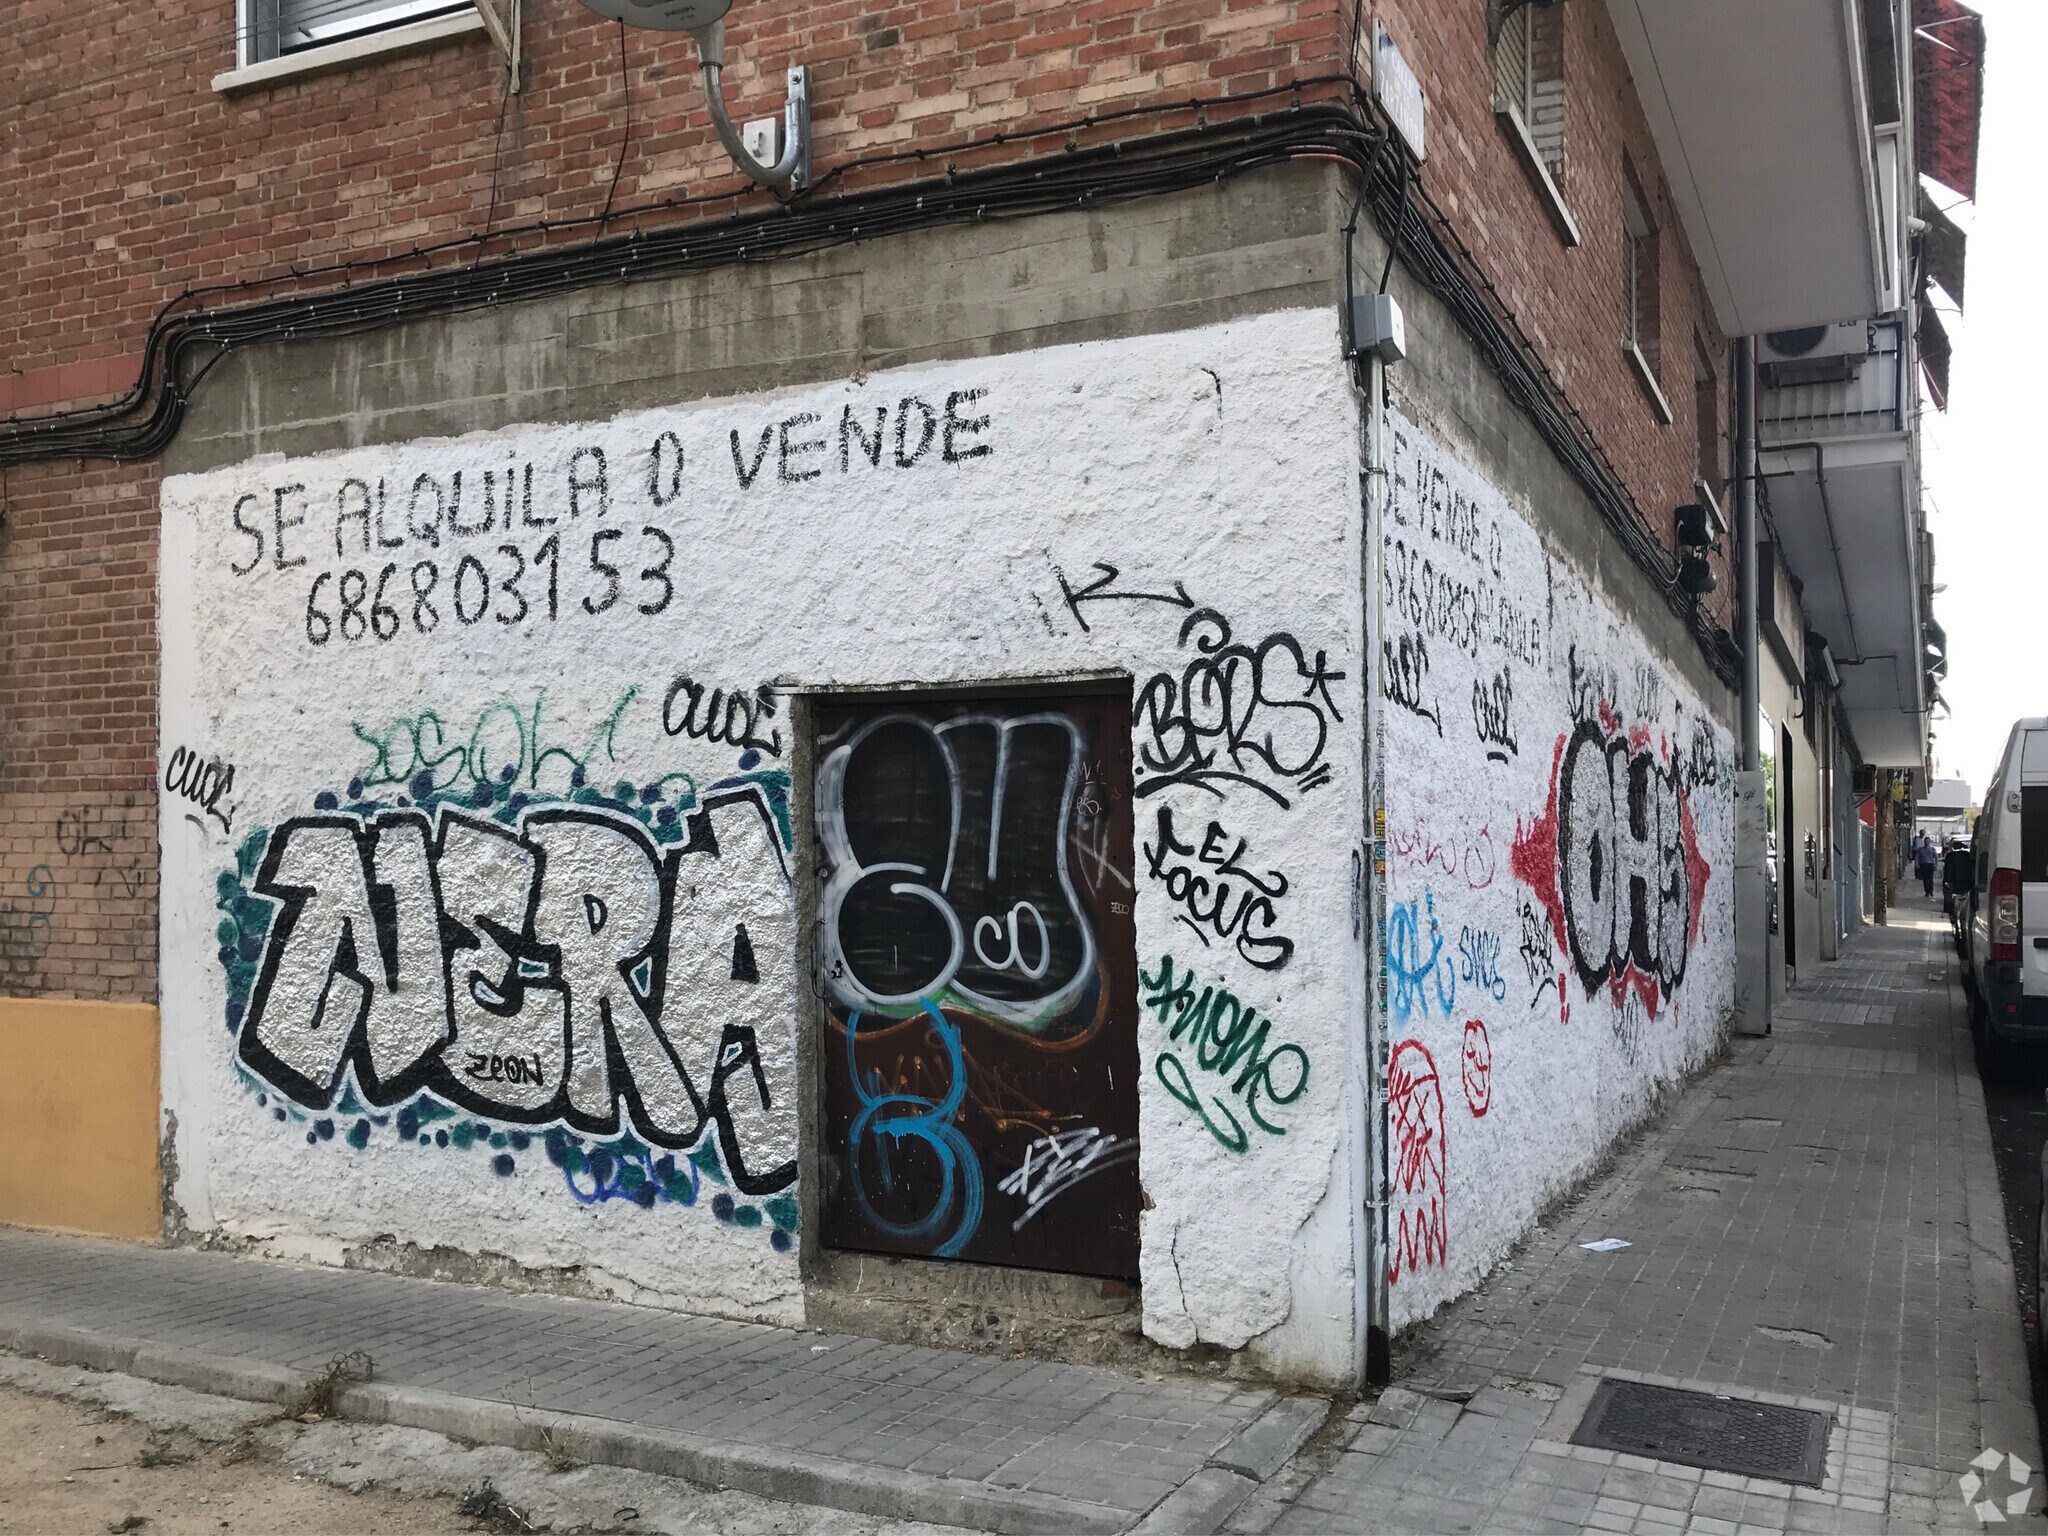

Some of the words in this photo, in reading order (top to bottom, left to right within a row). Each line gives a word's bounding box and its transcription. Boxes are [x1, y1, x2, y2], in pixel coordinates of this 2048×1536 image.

[231, 482, 308, 577] SE
[647, 430, 685, 506] O
[730, 387, 994, 491] VENDE
[1417, 453, 1481, 564] VENDE
[305, 526, 676, 647] 686803153
